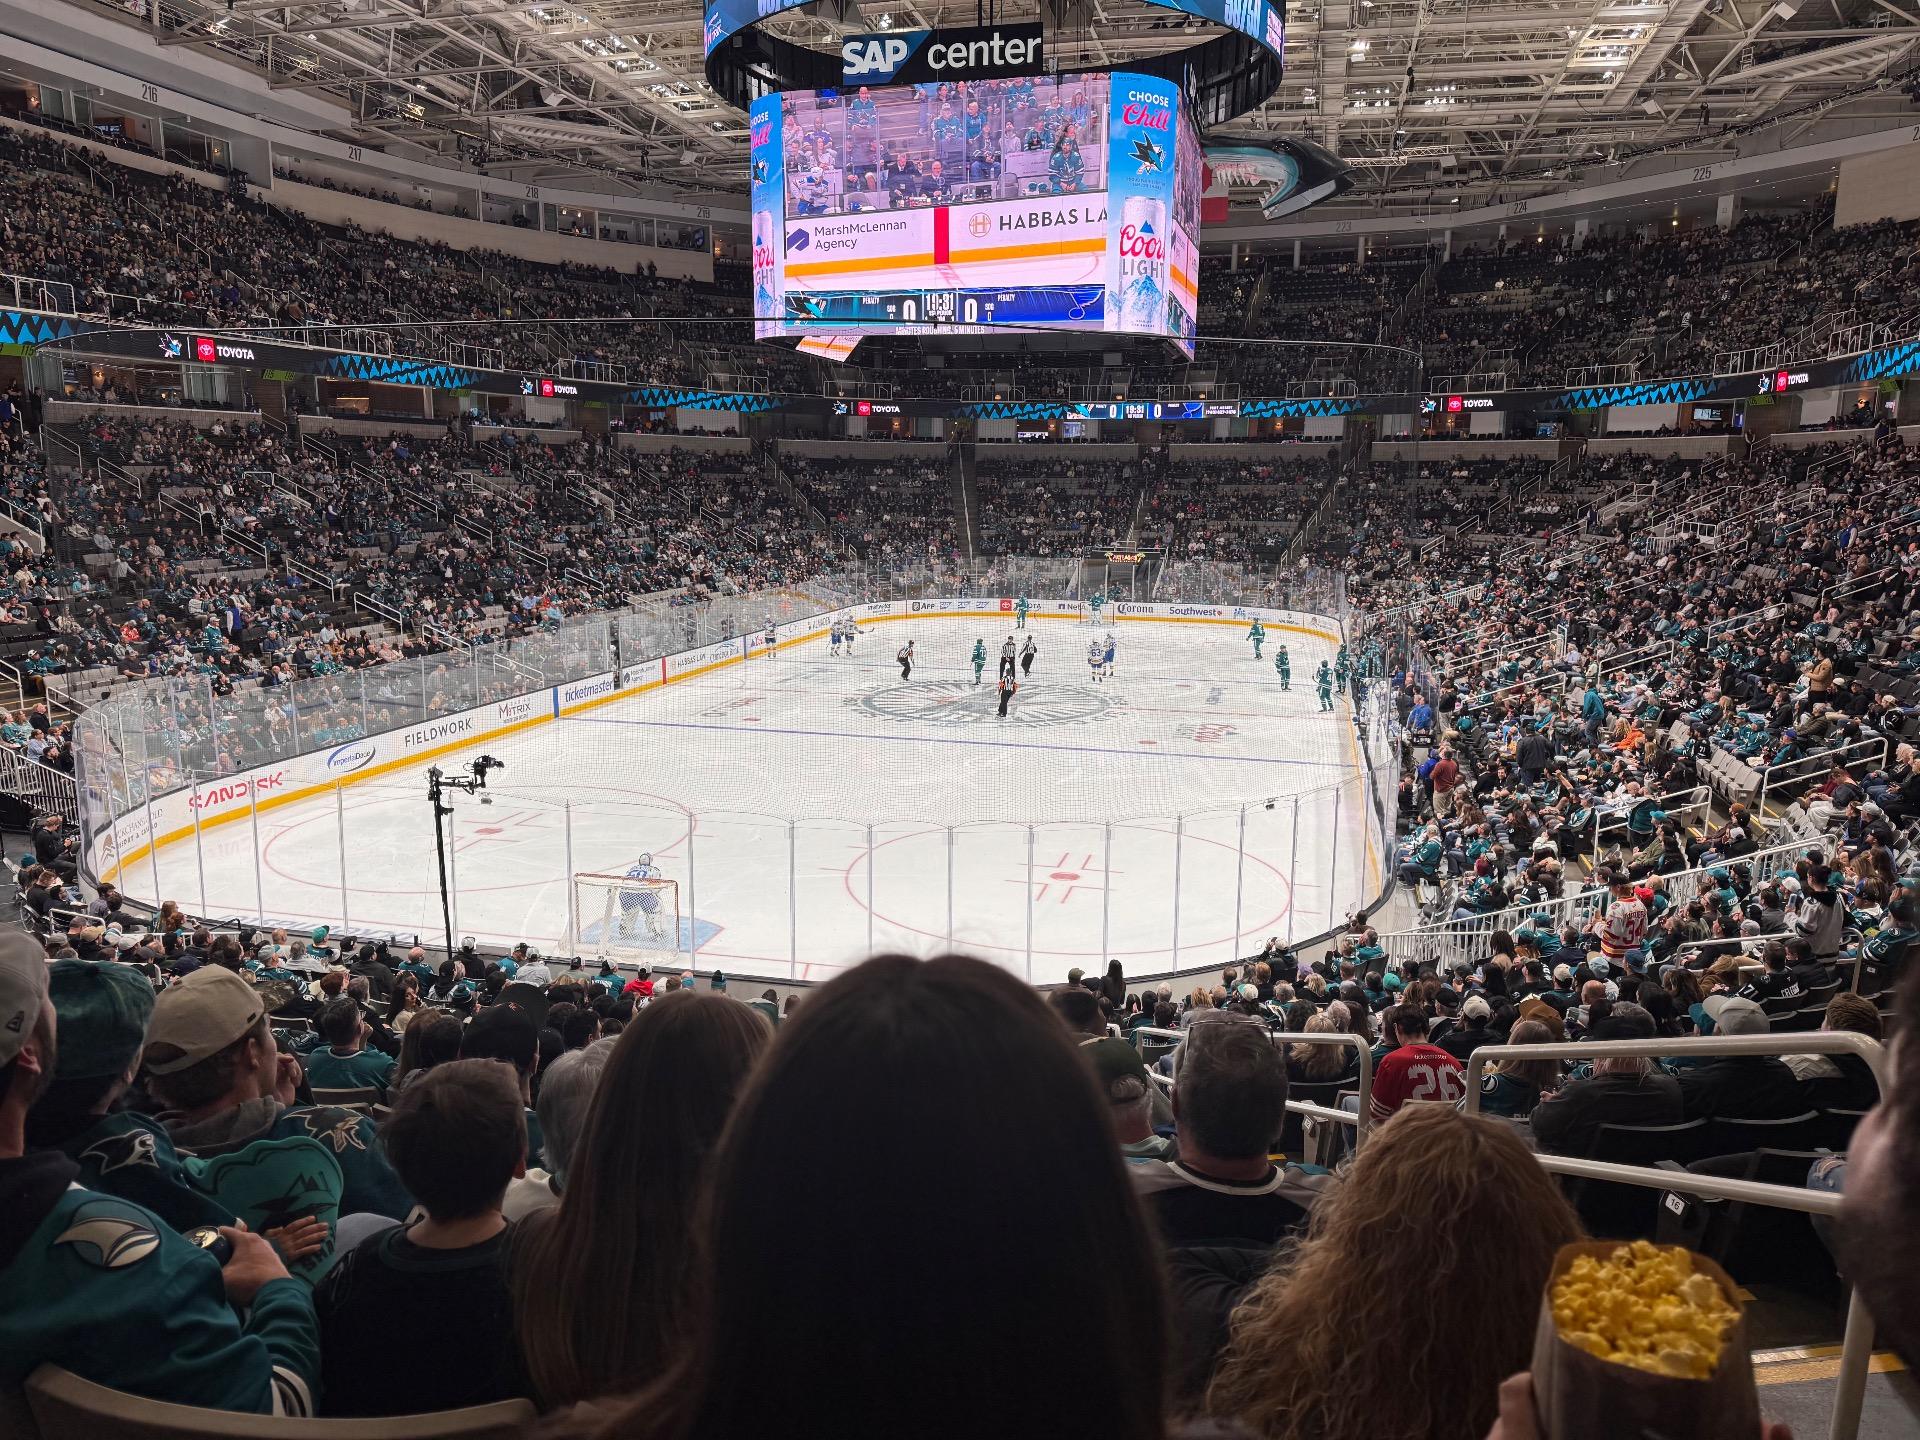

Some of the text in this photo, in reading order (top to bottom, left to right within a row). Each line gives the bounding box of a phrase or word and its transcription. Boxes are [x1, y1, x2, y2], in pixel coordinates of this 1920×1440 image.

[842, 32, 1042, 74] SAP center
[142, 83, 158, 102] 216
[1128, 91, 1169, 107] CHOOSE
[750, 111, 769, 126] HOOSE
[1122, 103, 1171, 132] Chill
[348, 146, 362, 161] 217
[1693, 167, 1711, 181] 225
[526, 186, 539, 199] 218
[1514, 202, 1528, 214] 224
[999, 208, 1079, 231] HABBAS
[814, 220, 907, 237] MarshMcLennan
[815, 237, 858, 252] Agency
[903, 299, 916, 320] 0
[964, 298, 978, 323] 0
[216, 345, 255, 360] TOYOTA
[1787, 373, 1809, 385] TOYOTA
[553, 384, 578, 395] TOYOTA
[871, 405, 900, 413] TOYOTA
[1109, 404, 1117, 418] 0
[1153, 404, 1162, 418] 0
[1463, 399, 1494, 408] TOYOTA
[1117, 602, 1154, 614] Corona
[1169, 606, 1217, 617] Southwest
[565, 679, 614, 702] ticketmaster
[404, 717, 473, 748] FIELDWORK
[1407, 1063, 1461, 1101] 26
[1671, 1198, 1681, 1211] 16
